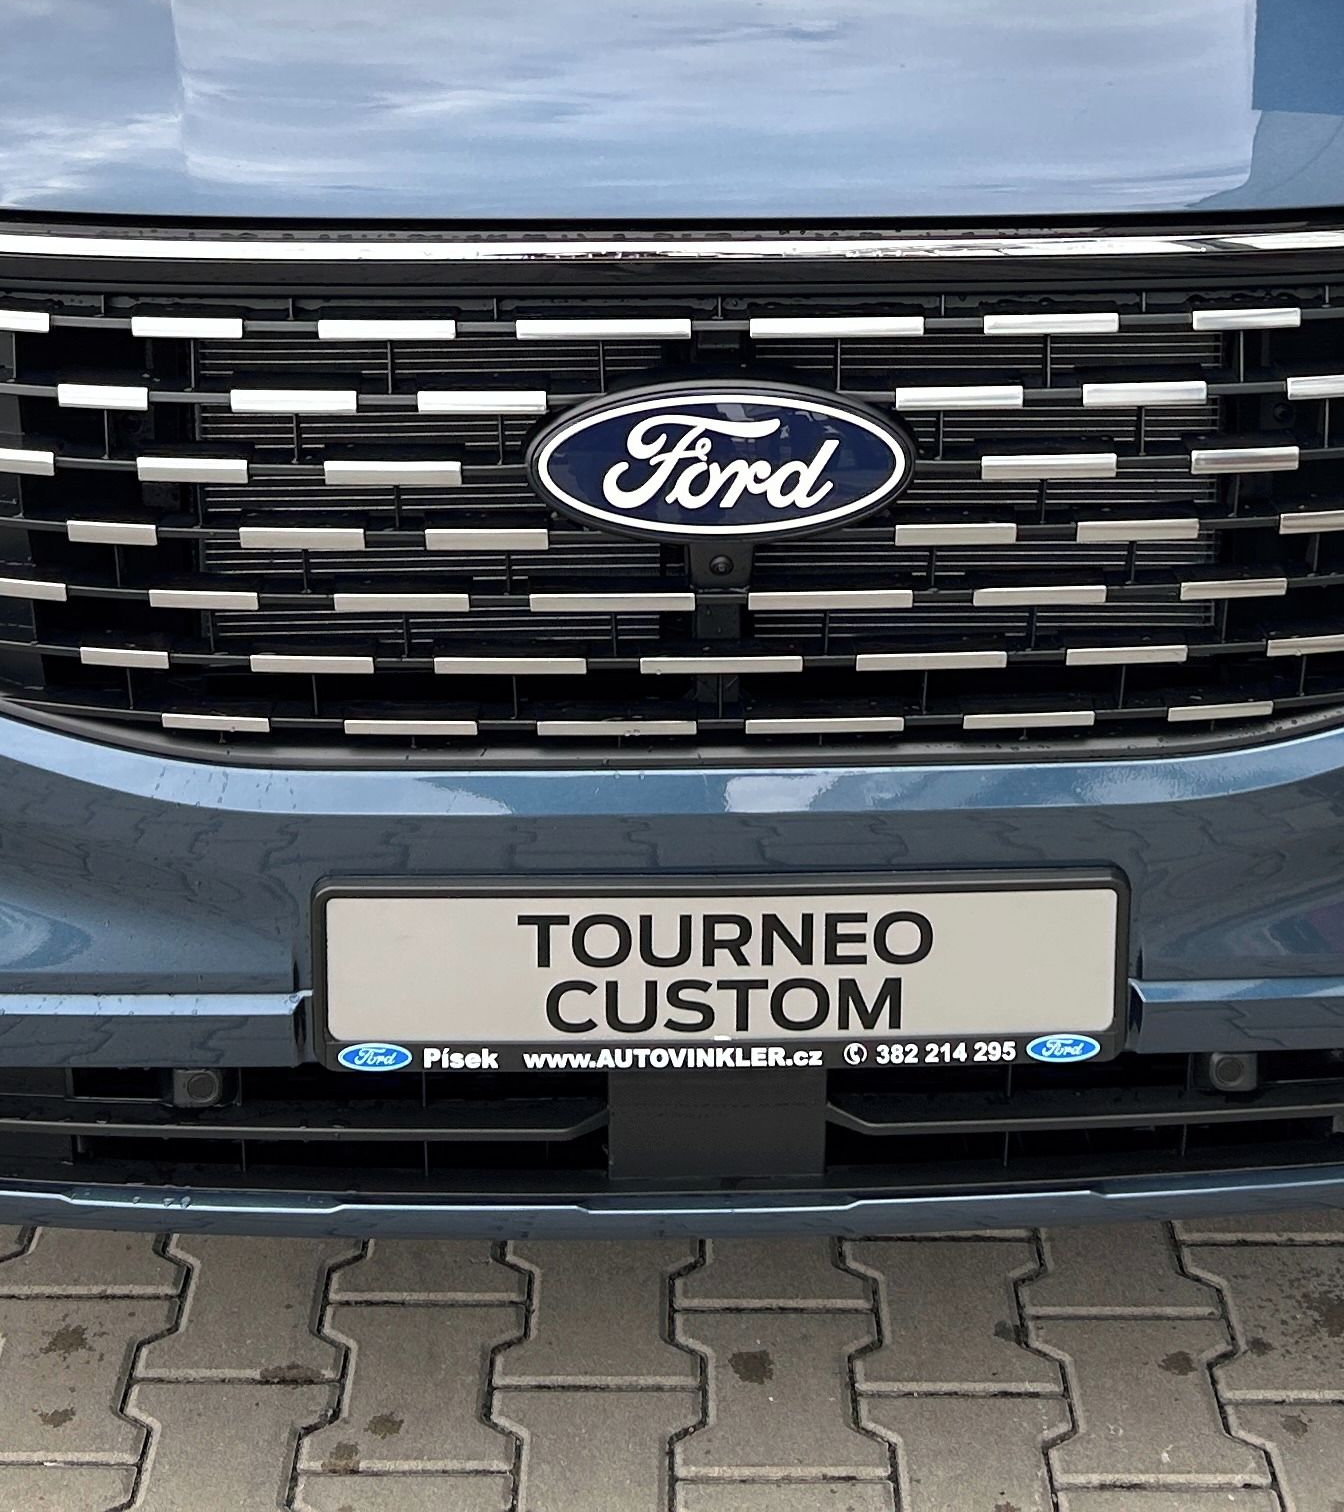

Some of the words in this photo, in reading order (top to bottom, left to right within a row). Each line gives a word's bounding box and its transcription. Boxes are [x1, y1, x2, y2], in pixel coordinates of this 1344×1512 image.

[602, 414, 840, 509] Ford
[517, 911, 934, 968] TOURNEO
[545, 977, 902, 1033] CUSTOM
[354, 1047, 397, 1066] Ford
[423, 1047, 499, 1069] Písek
[522, 1046, 823, 1070] www.AUTOVINKLER.cz
[875, 1044, 918, 1064] 382
[924, 1042, 968, 1063] 214
[973, 1041, 1017, 1062] 295
[1041, 1039, 1084, 1057] Ford
